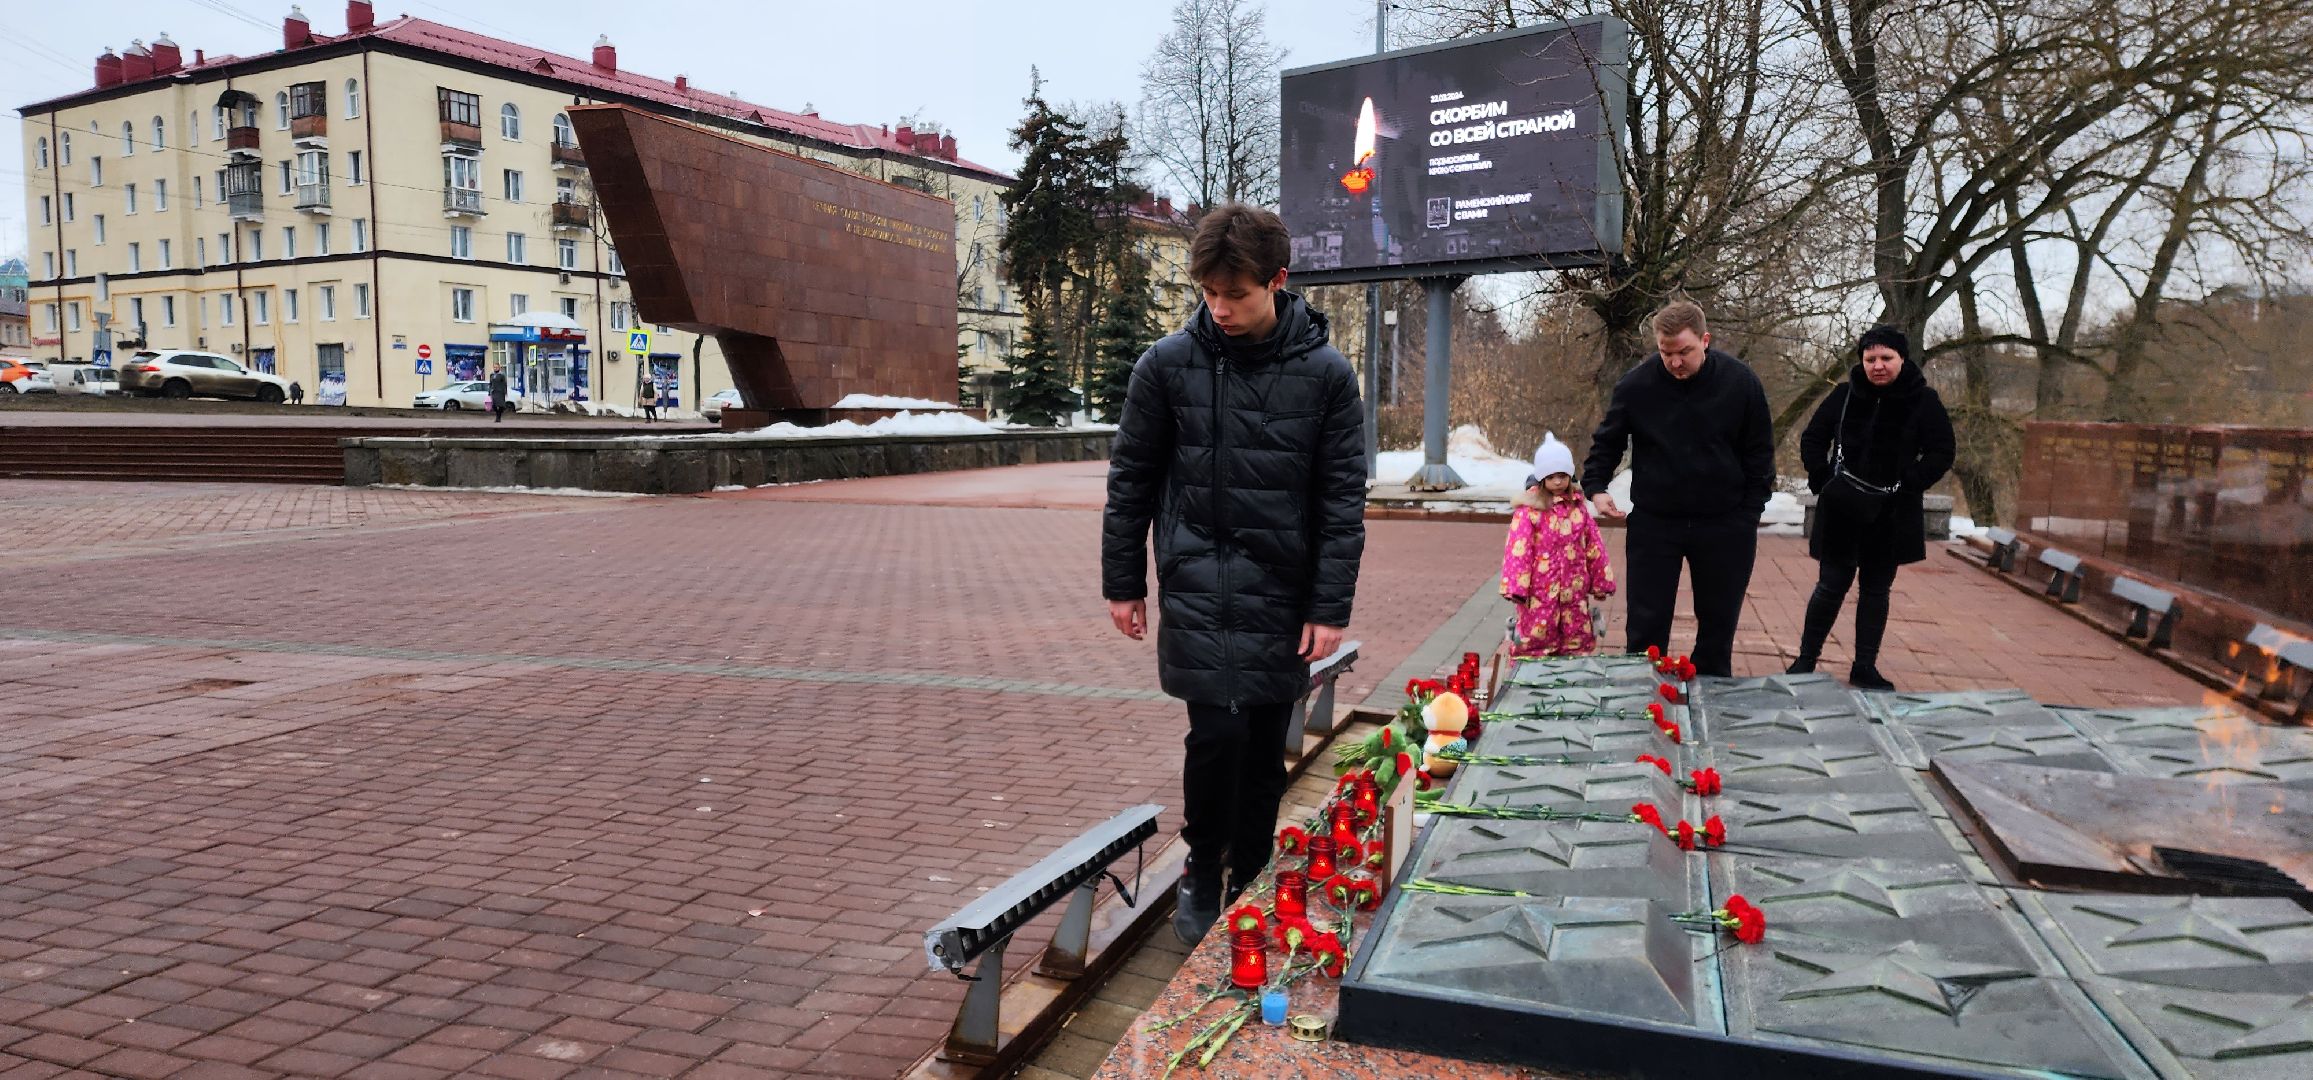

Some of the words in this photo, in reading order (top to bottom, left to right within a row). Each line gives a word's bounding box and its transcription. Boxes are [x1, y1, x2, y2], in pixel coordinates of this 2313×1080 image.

[1430, 100, 1508, 125] СКОРБИМ
[1429, 131, 1453, 147] СО
[1453, 120, 1496, 144] ВСЕЙ
[1497, 108, 1576, 138] СТРАНОЙ
[1455, 194, 1506, 210] РАМЕНСКИЙ
[1454, 211, 1462, 221] С
